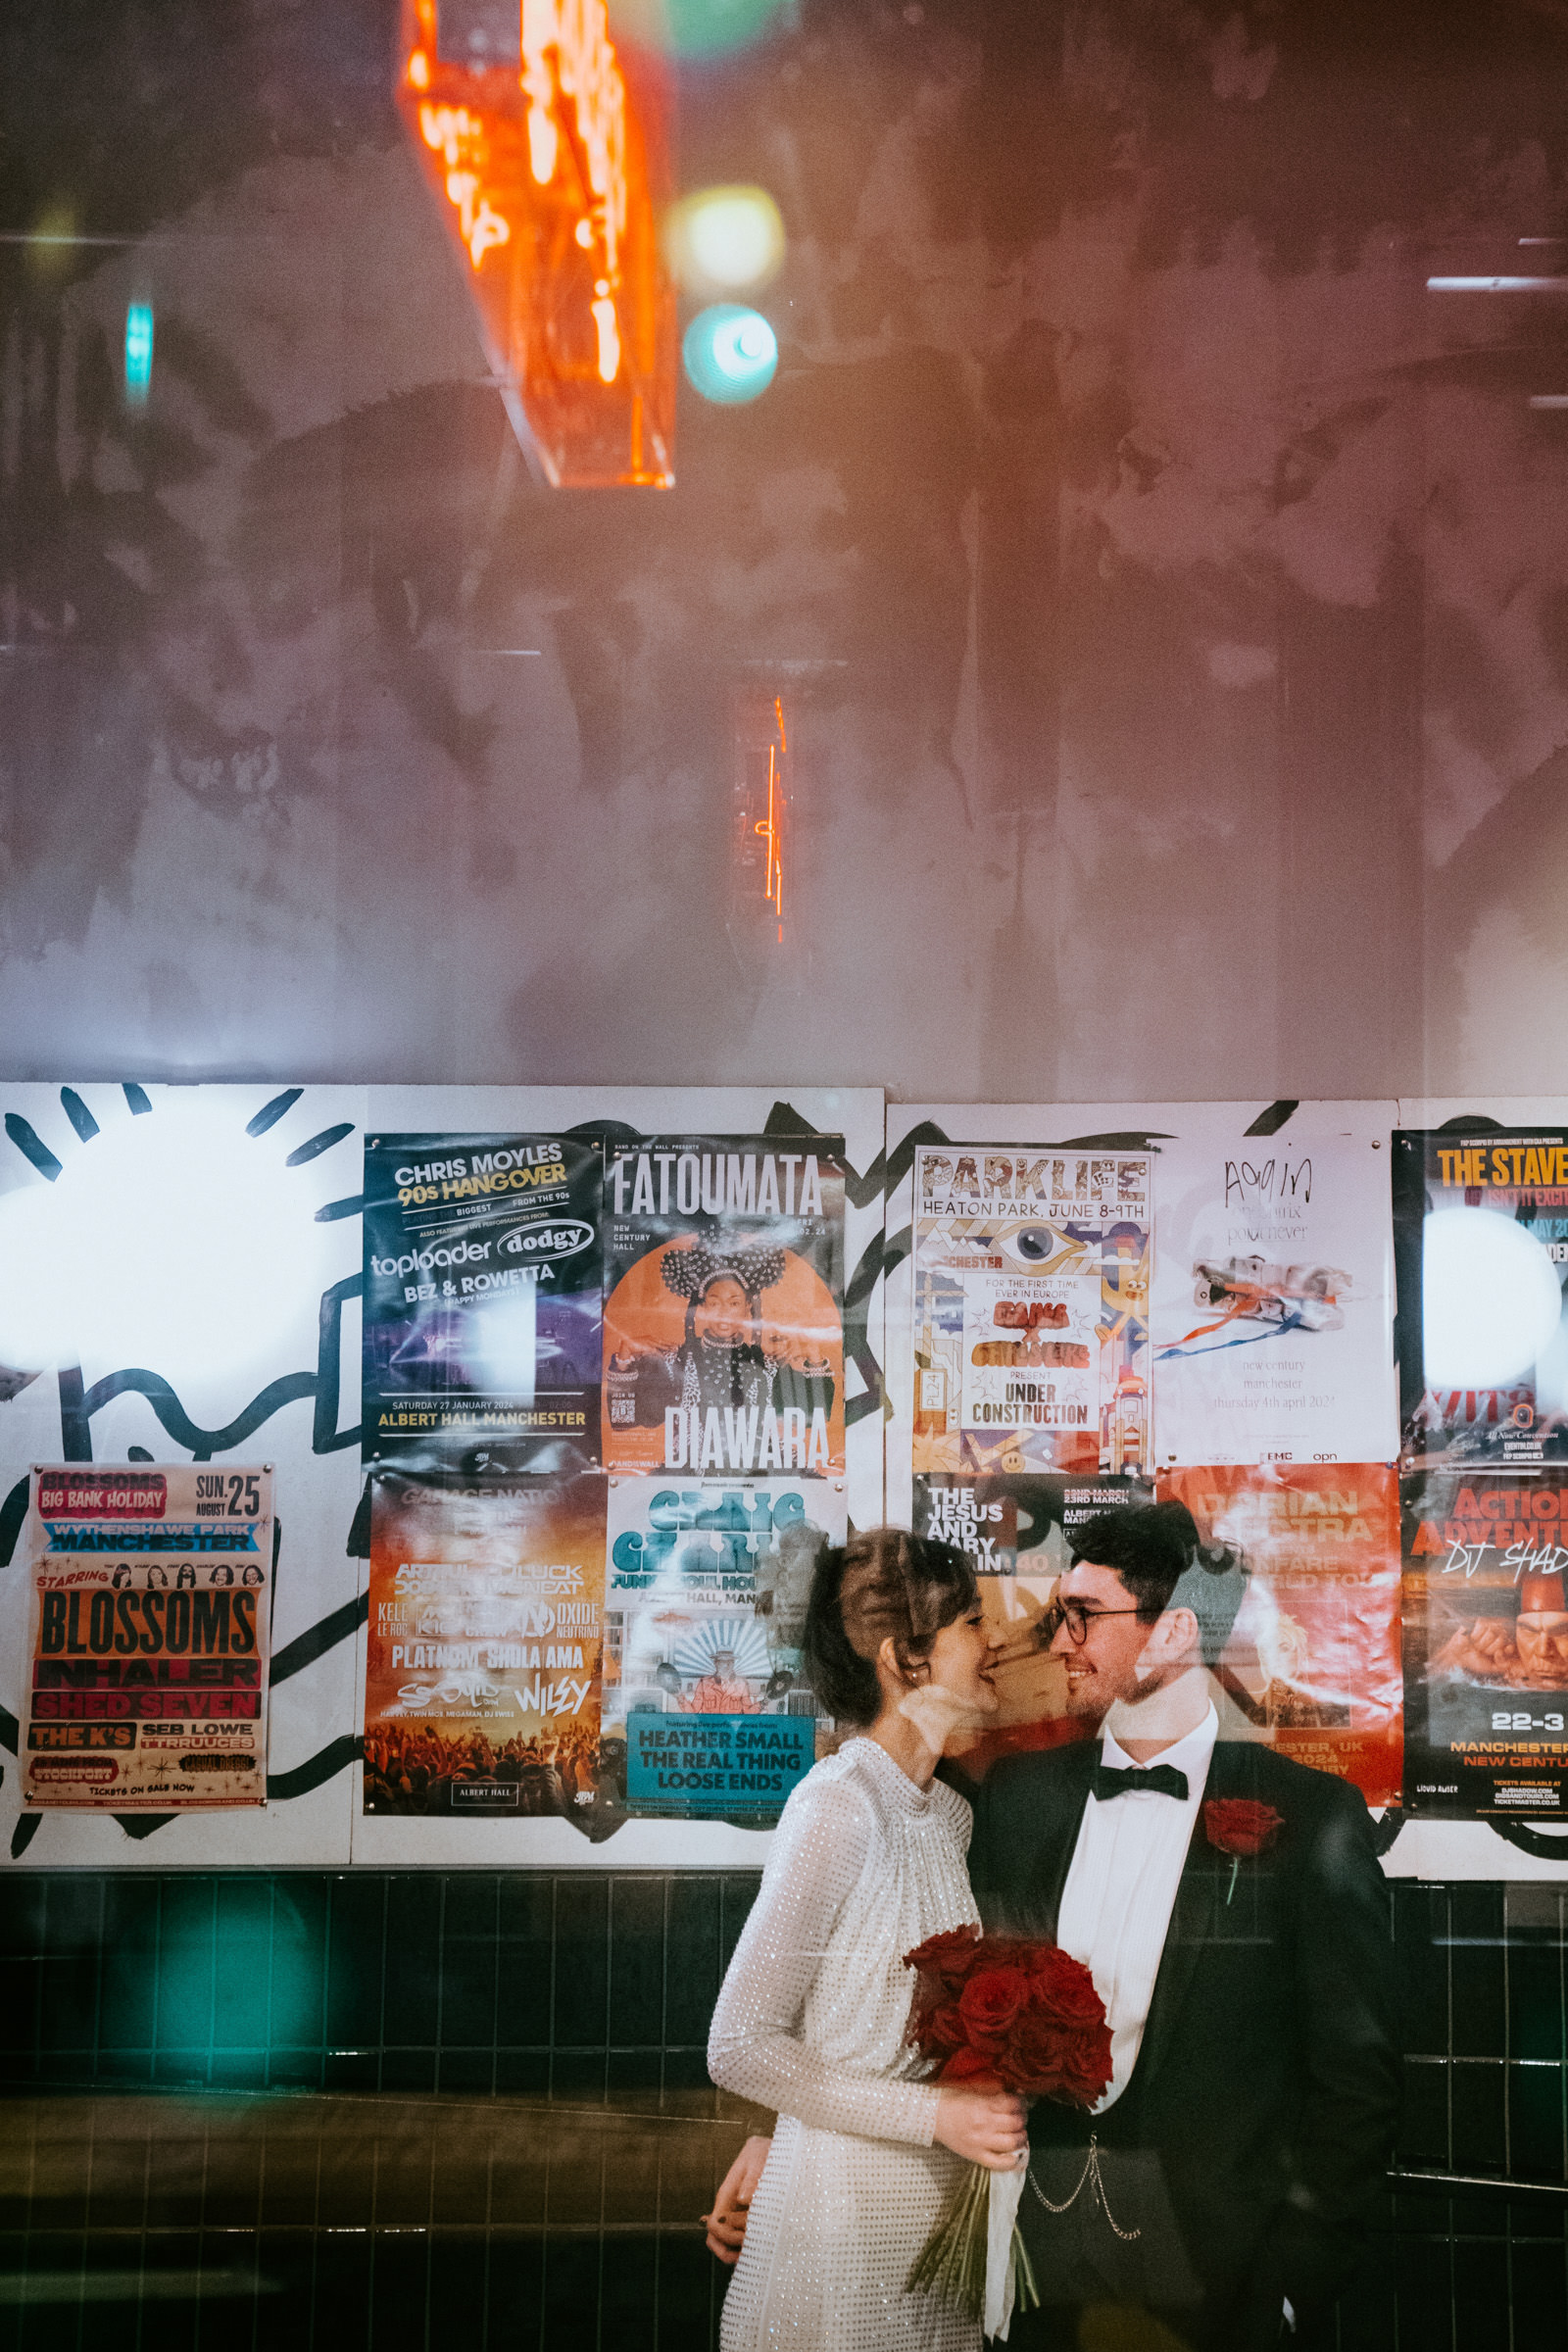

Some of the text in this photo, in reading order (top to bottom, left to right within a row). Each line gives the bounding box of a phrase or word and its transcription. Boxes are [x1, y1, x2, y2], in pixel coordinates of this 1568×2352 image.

[394, 1143, 564, 1186] CHRIS MOYLES
[1437, 1147, 1568, 1188] THE STAVE
[398, 1162, 568, 1206] 90s HANGOVER
[613, 1152, 823, 1216] FATOUMATA
[922, 1154, 1147, 1202] PARKLIFE
[456, 1204, 492, 1216] BIGGEST
[513, 1197, 537, 1207] FROM
[538, 1194, 555, 1203] THE
[923, 1201, 1145, 1218] HEATON PARK, JUNE 8-9TH
[481, 1215, 530, 1229] PERFORMANCES
[369, 1227, 583, 1279] toploader dodgy
[404, 1262, 556, 1304] BEZ & ROWETTA
[1028, 1280, 1054, 1289] FIRST
[1057, 1280, 1079, 1289] TIME
[996, 1290, 1018, 1298] EVER
[1033, 1291, 1069, 1299] EUROPE
[1010, 1371, 1052, 1380] PRESENT
[1244, 1377, 1303, 1389] manchester
[1005, 1383, 1056, 1403] UNDER
[392, 1401, 437, 1410] SATURDAY
[1214, 1395, 1306, 1411] thursday 4th april
[378, 1412, 586, 1427] ALBERT HALL MANCHESTER
[972, 1402, 1088, 1424] CONSTRUCTION
[664, 1405, 830, 1469] DIAWARA
[1312, 1452, 1338, 1463] opn
[42, 1473, 165, 1491] BLOSSOMS
[41, 1491, 164, 1508] BIG BANK HOLIDAY
[196, 1475, 261, 1517] SUN. 25
[927, 1487, 975, 1505] THE
[196, 1502, 225, 1516] AUGUST
[927, 1504, 1004, 1522] JESUS
[53, 1524, 250, 1536] WYTHENSHAWE PARK
[927, 1521, 978, 1539] AND
[1410, 1520, 1568, 1556] ADVENT
[49, 1534, 250, 1550] MANCHESTER
[1442, 1538, 1568, 1584] DJ SHAD
[36, 1570, 109, 1590] STARRING
[378, 1602, 409, 1622] KELE
[556, 1602, 600, 1625] OXIDE
[40, 1591, 257, 1655] BLOSSOMS
[377, 1623, 388, 1637] LE
[556, 1625, 600, 1640] NEUTRINO
[545, 1645, 584, 1669] AMA
[37, 1658, 260, 1689] INHALER
[35, 1693, 257, 1718] SHED SEVEN
[142, 1723, 253, 1736] SEB LOWE
[1492, 1712, 1565, 1732] 22-3
[30, 1727, 131, 1746] THE K'S
[141, 1738, 255, 1748] TTRRUUCES
[639, 1730, 804, 1750] HEATHER SMALL
[1339, 1741, 1364, 1753] UK
[640, 1750, 802, 1771] THE REAL THING
[1463, 1755, 1568, 1768] NEW CENTU
[89, 1784, 195, 1796] TICKETS ON SALE NOW
[658, 1772, 783, 1791] LOOSE ENDS
